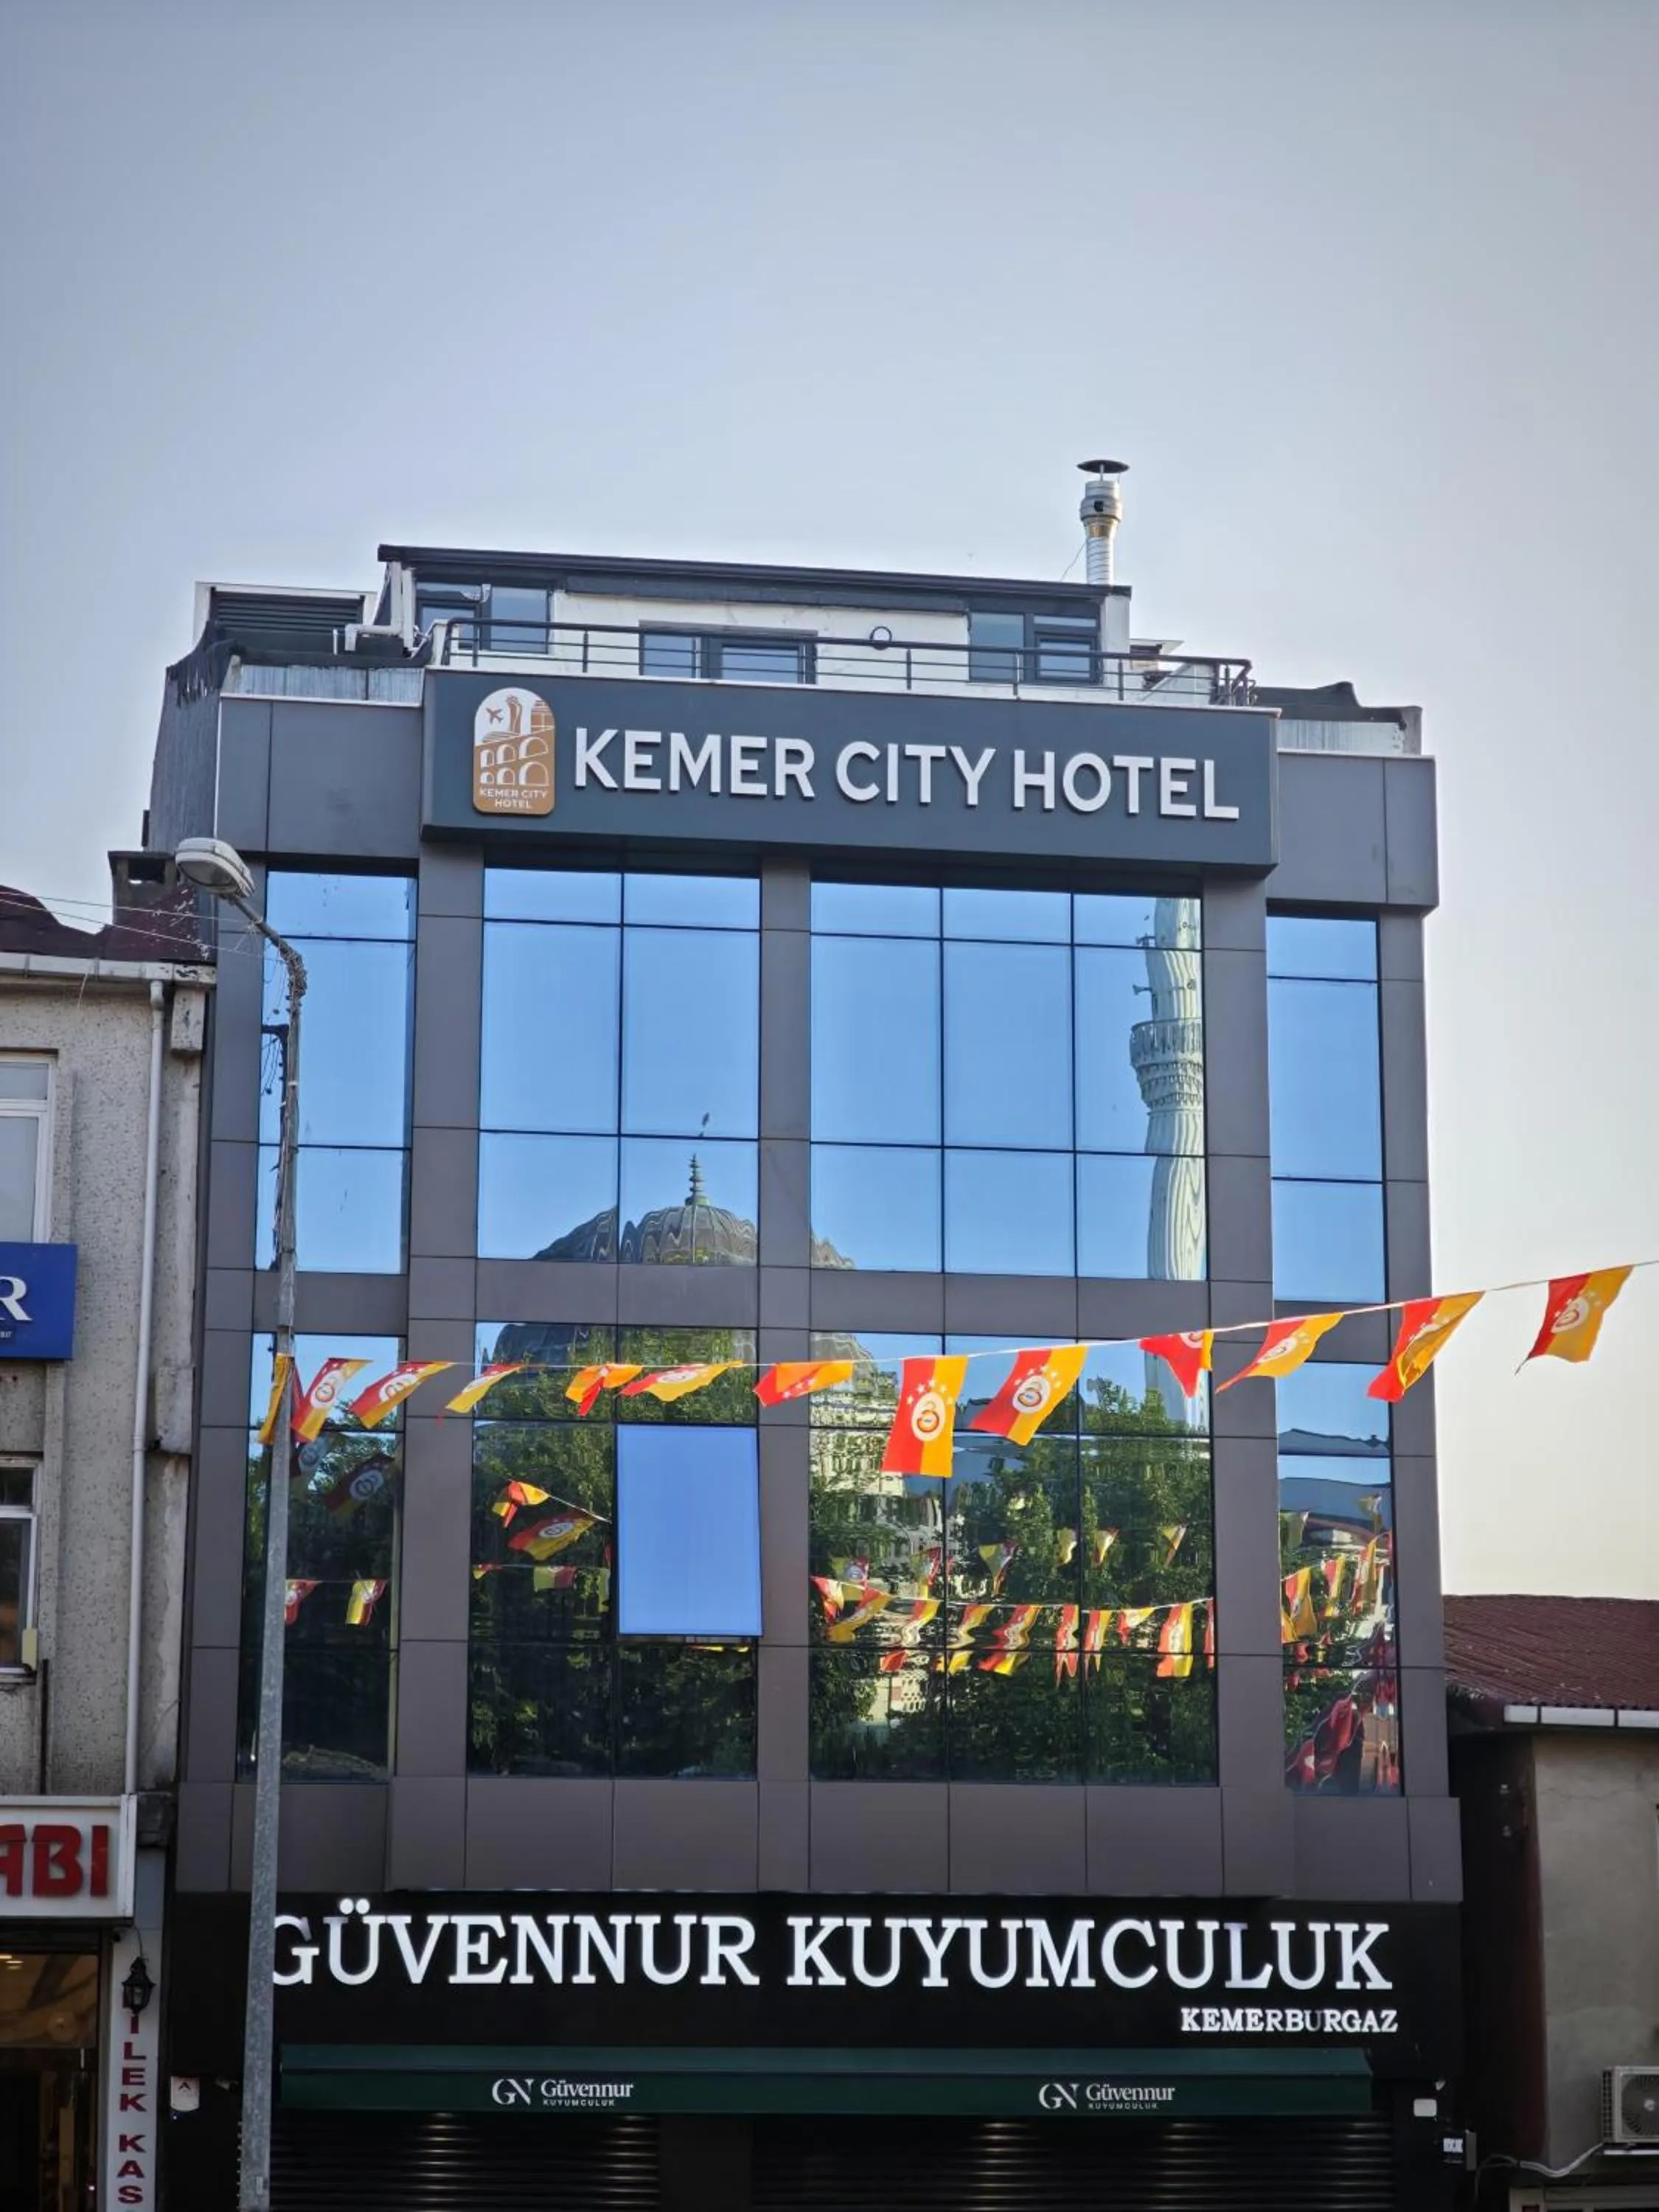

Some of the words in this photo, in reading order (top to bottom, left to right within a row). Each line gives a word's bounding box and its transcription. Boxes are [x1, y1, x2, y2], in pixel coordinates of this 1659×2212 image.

[575, 727, 815, 799] KEMER
[836, 741, 995, 807] CITY
[1013, 750, 1239, 820] HOTEL
[480, 787, 519, 798] KEMER
[521, 789, 549, 799] CITY
[495, 799, 532, 809] HOTEL
[273, 1898, 760, 1985] GÜVENNUR
[787, 1916, 1393, 1990] KUYUMCULUK
[1180, 2007, 1399, 2033] KEMERBURGAZ
[492, 2079, 535, 2105] GN
[540, 2079, 634, 2098] Güvennur
[1039, 2083, 1080, 2110] GN
[1086, 2084, 1175, 2101] Güvennur
[117, 2135, 147, 2212] KAS
